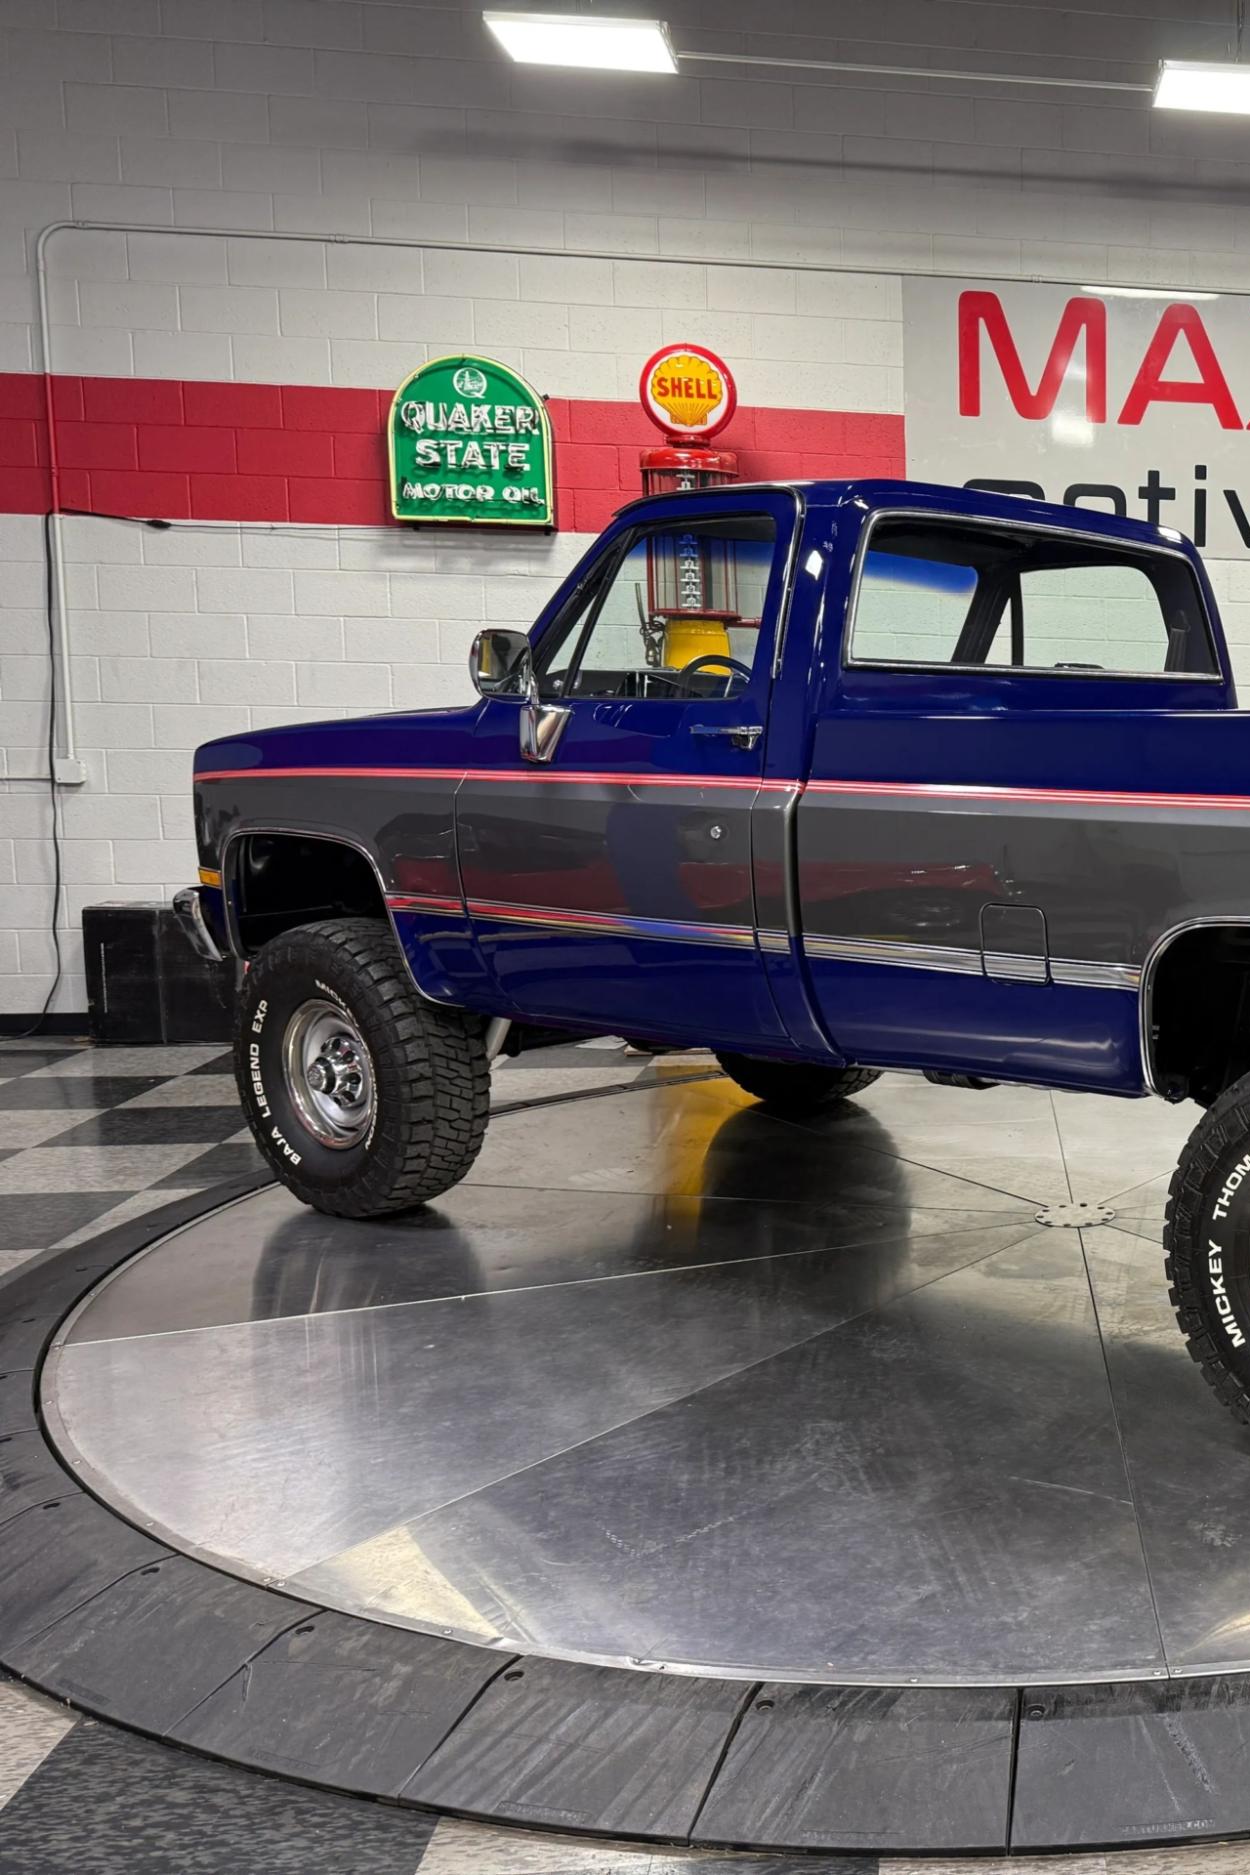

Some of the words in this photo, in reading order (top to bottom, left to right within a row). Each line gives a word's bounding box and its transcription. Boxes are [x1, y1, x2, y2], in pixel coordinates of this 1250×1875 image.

[656, 376, 719, 400] SHELL
[401, 401, 539, 434] QUAKER
[416, 439, 530, 471] STATE
[402, 482, 495, 502] MOTOR
[501, 486, 545, 505] OIL
[253, 999, 269, 1034] EXP
[249, 1043, 272, 1119] LEGEND
[271, 1126, 302, 1166] BAJA
[1207, 1240, 1246, 1349] MICKEY
